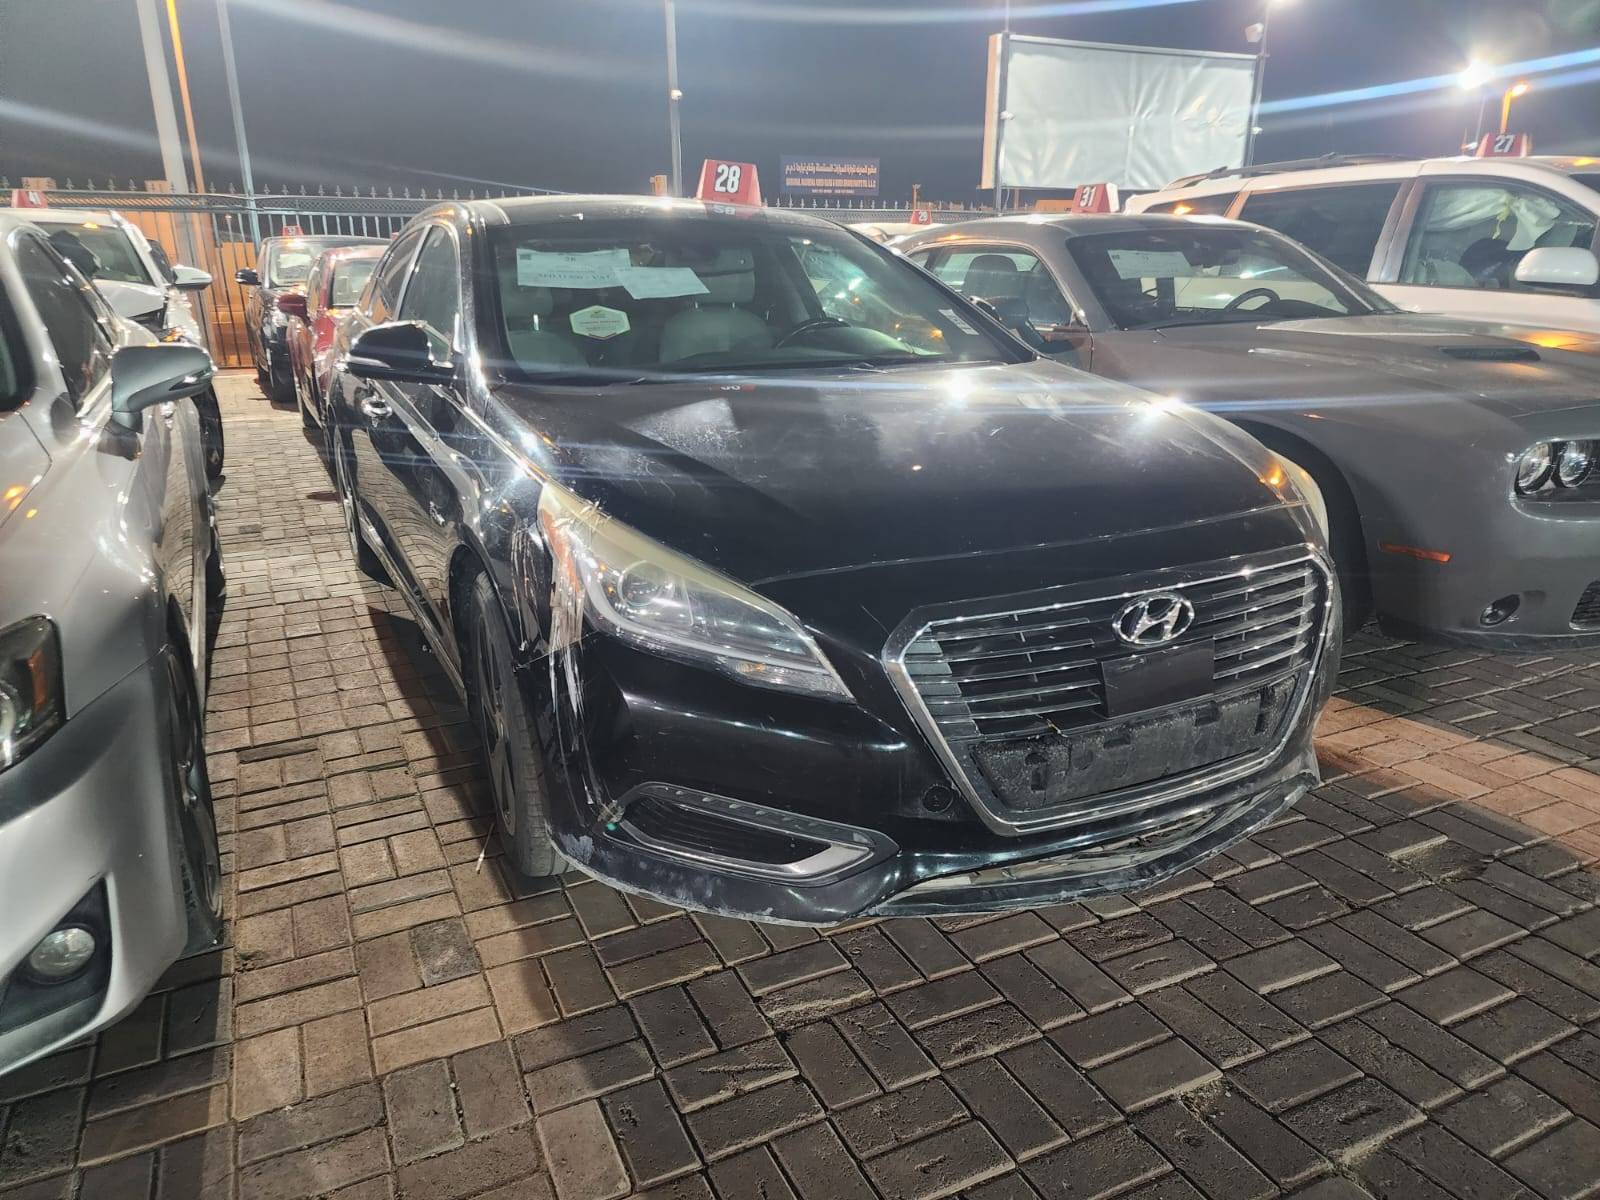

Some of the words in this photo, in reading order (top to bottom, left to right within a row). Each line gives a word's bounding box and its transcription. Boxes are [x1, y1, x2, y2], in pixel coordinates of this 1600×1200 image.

[1494, 134, 1514, 153] 27
[714, 164, 741, 193] 28
[1080, 186, 1097, 207] 31
